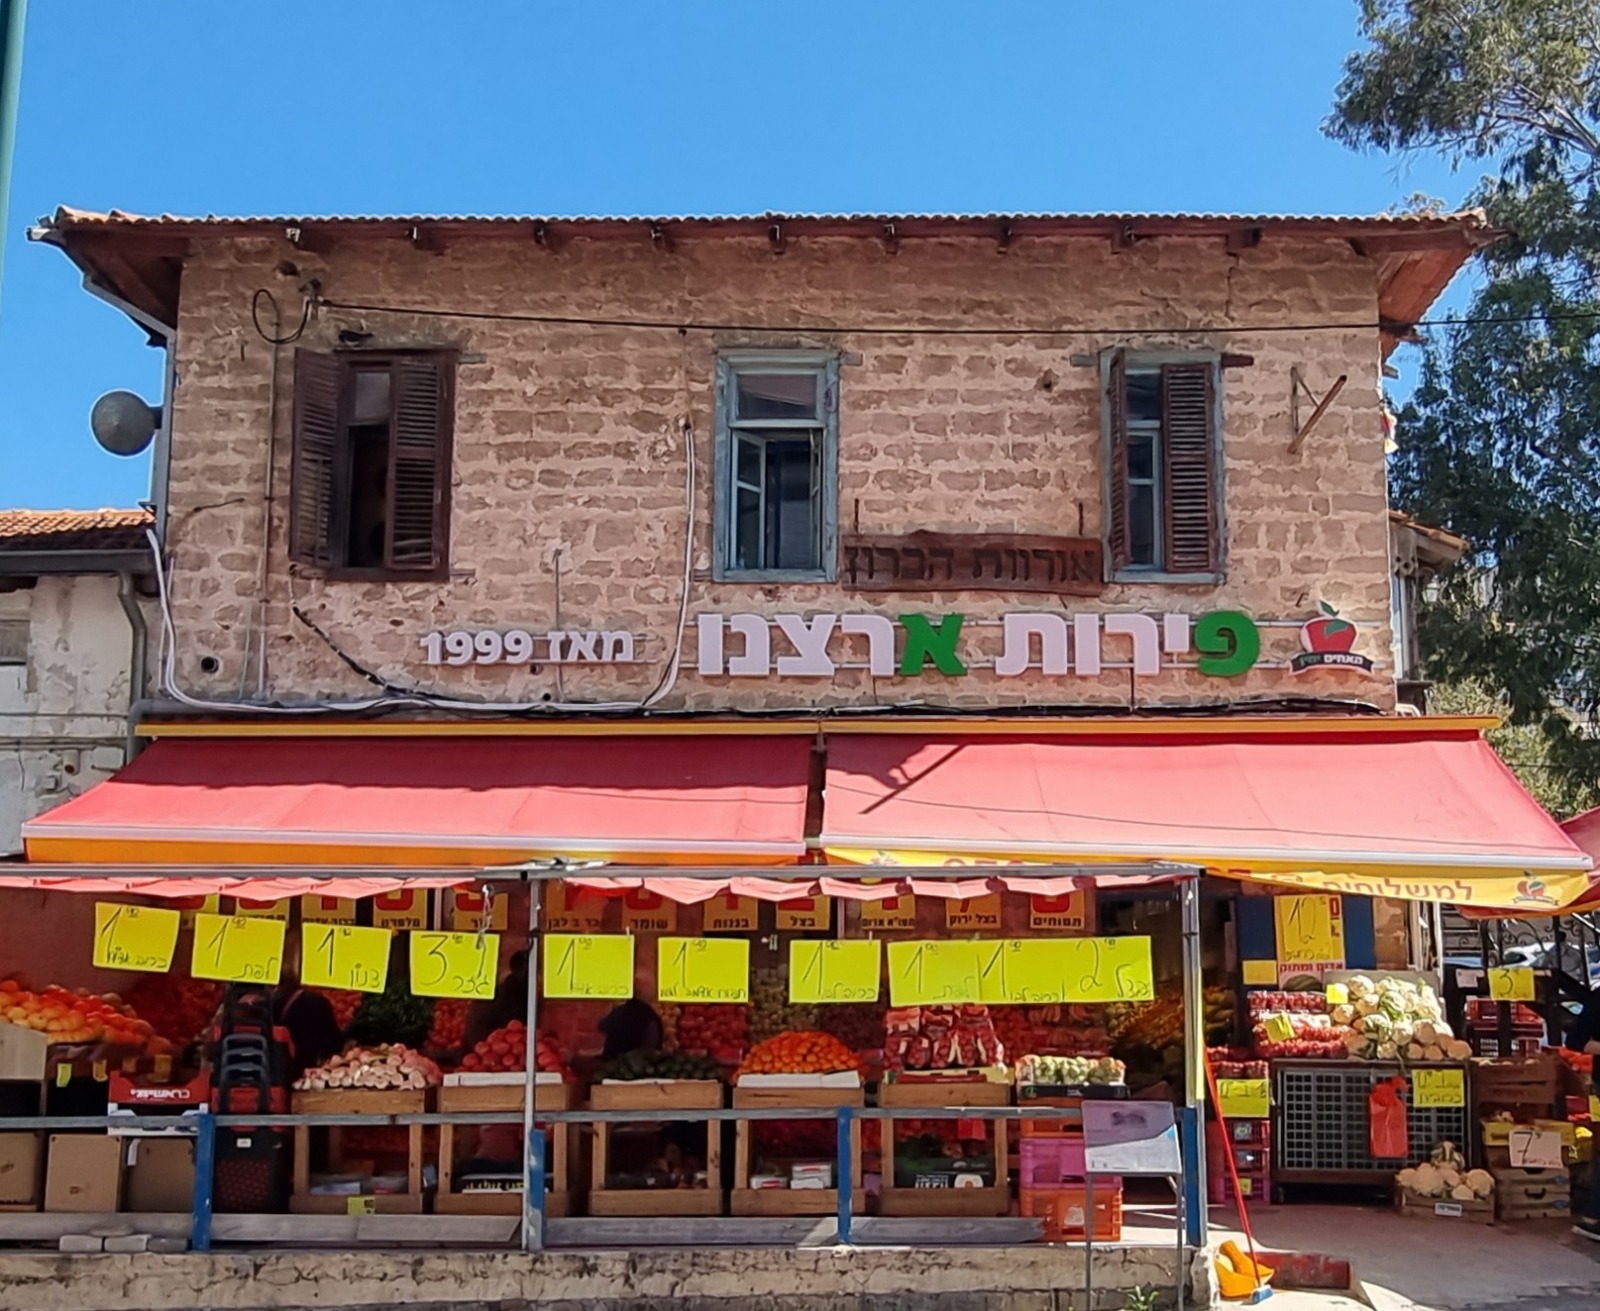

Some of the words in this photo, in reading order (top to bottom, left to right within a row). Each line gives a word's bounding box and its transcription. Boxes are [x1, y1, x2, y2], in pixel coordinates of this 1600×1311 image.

[420, 630, 534, 666] 1999
[547, 630, 634, 662] מאז
[698, 612, 968, 677] ארצנו
[995, 610, 1260, 677] פירות
[1323, 654, 1364, 665] האחים
[420, 935, 449, 987] 3
[1076, 938, 1103, 993] 2
